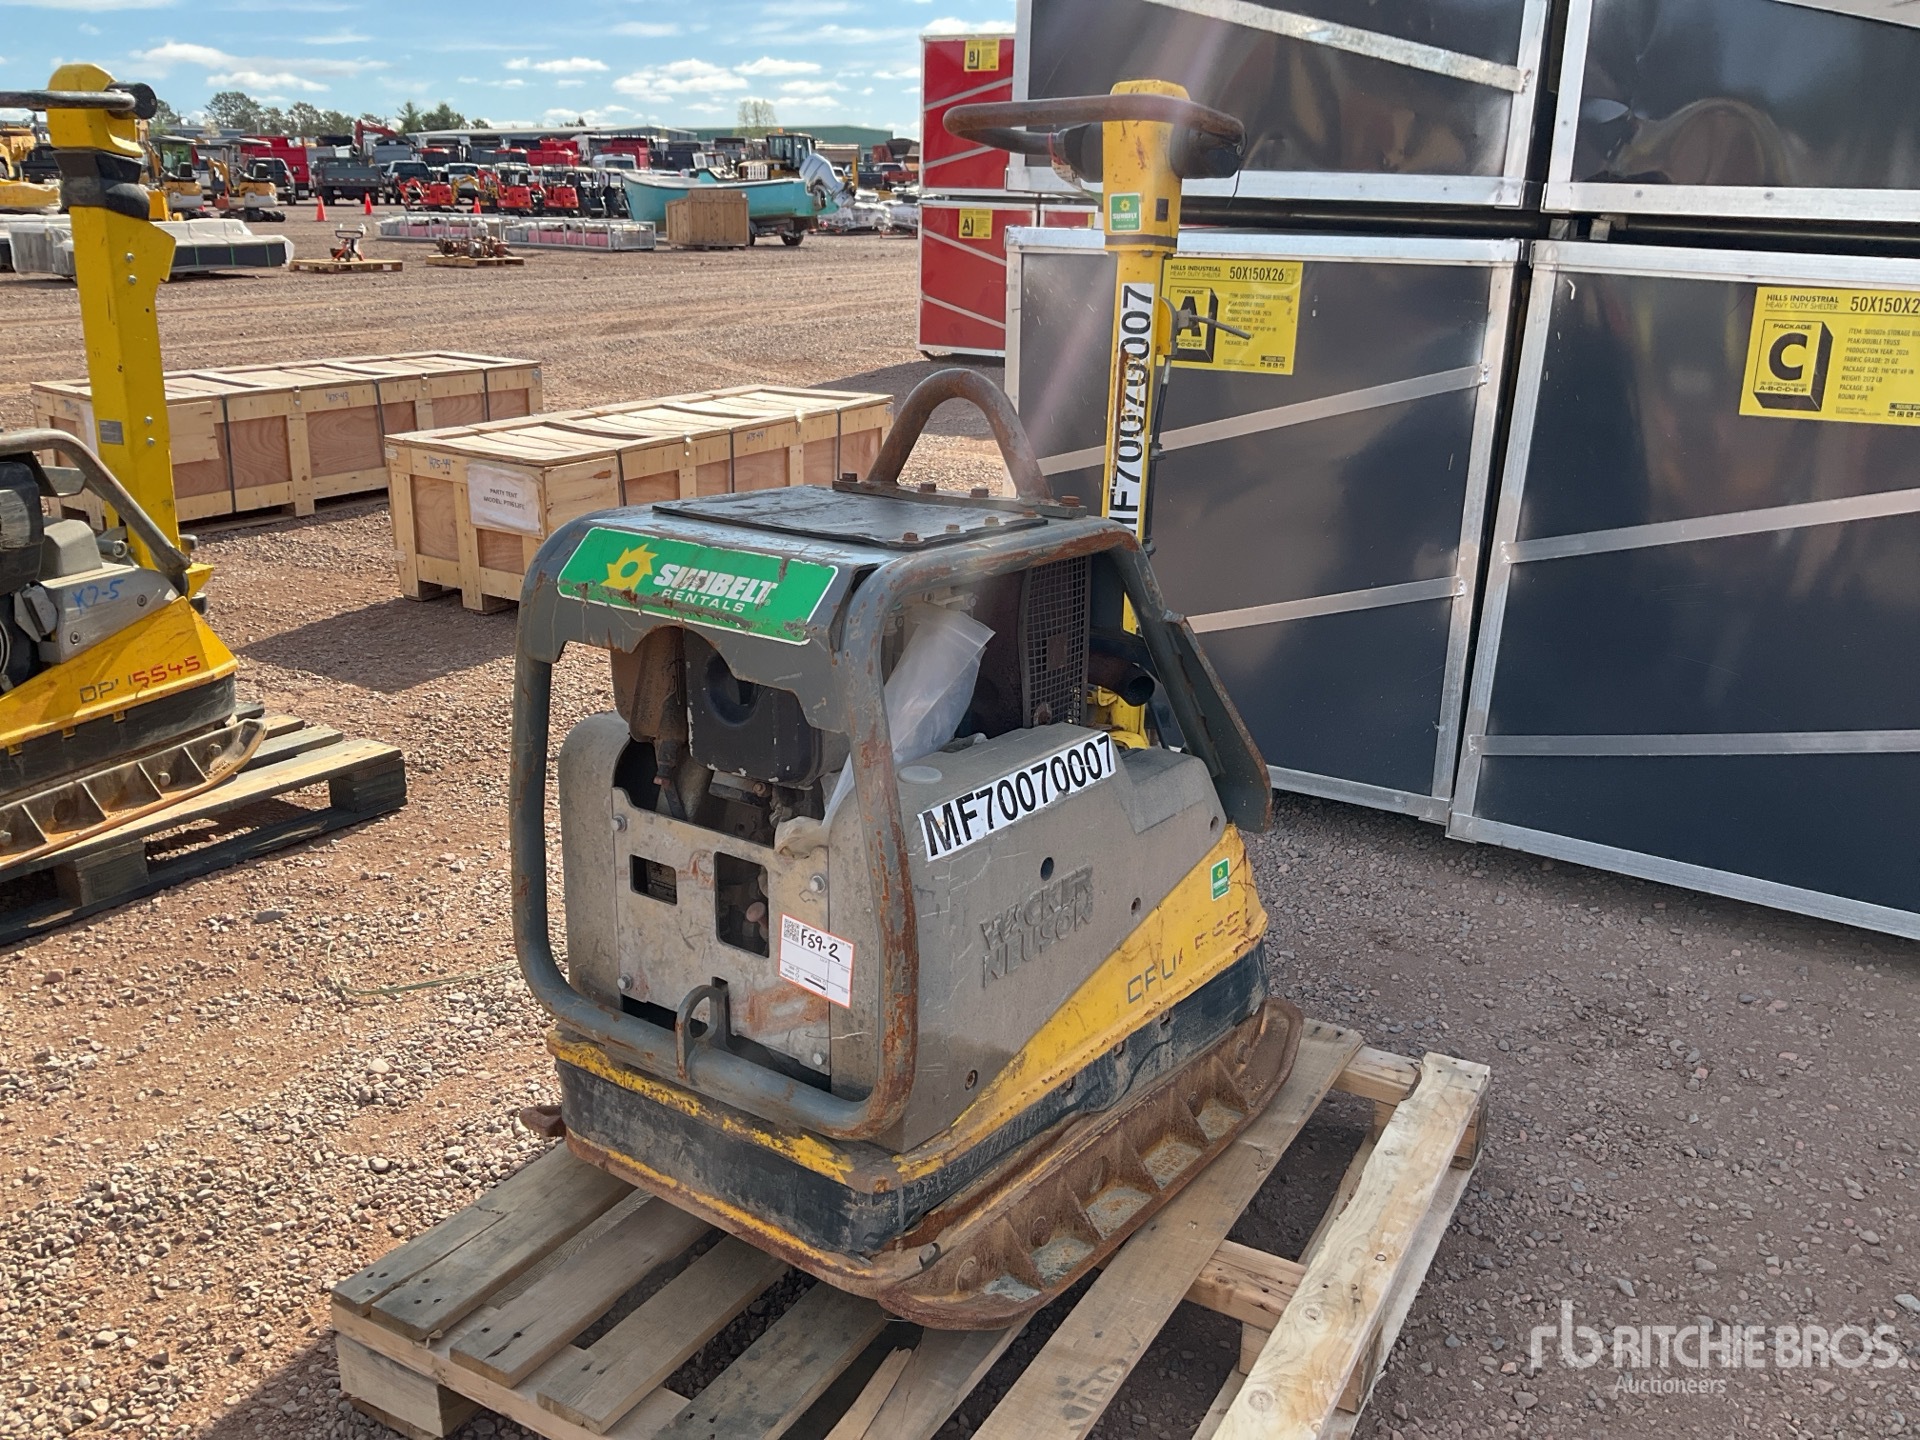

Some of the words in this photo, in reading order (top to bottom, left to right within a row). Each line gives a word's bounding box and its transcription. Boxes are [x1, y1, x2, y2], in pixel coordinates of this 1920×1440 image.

[962, 218, 970, 230] A
[1229, 266, 1285, 282] 50X150X26
[1789, 295, 1839, 303] INDUSTRIAL
[1789, 302, 1809, 310] DUTY
[1809, 303, 1838, 311] SHELTER
[1177, 296, 1202, 337] A
[1773, 323, 1812, 331] PACKAGE
[1768, 332, 1808, 381] C
[505, 490, 518, 498] TENT
[660, 589, 746, 613] RENTALS
[921, 734, 1113, 857] MF70070007
[800, 928, 841, 963] F59-2
